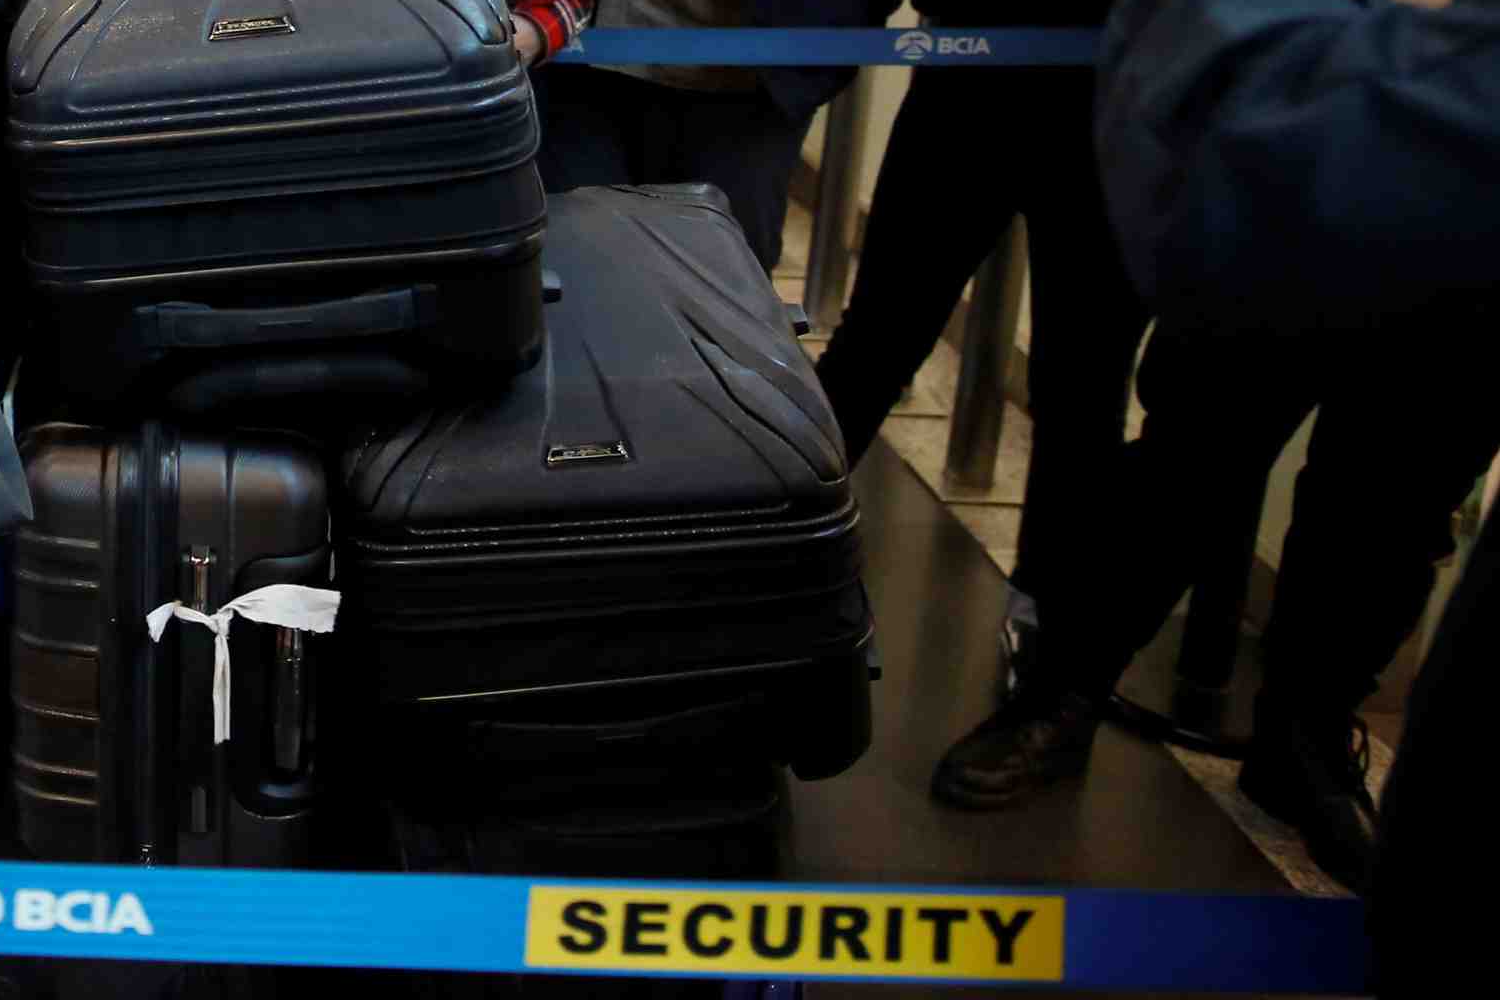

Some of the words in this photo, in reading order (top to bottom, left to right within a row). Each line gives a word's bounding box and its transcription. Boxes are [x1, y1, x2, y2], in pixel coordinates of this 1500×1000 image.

[937, 37, 990, 55] BCIA
[13, 888, 154, 936] BCIA
[558, 900, 1035, 965] SECURITY
